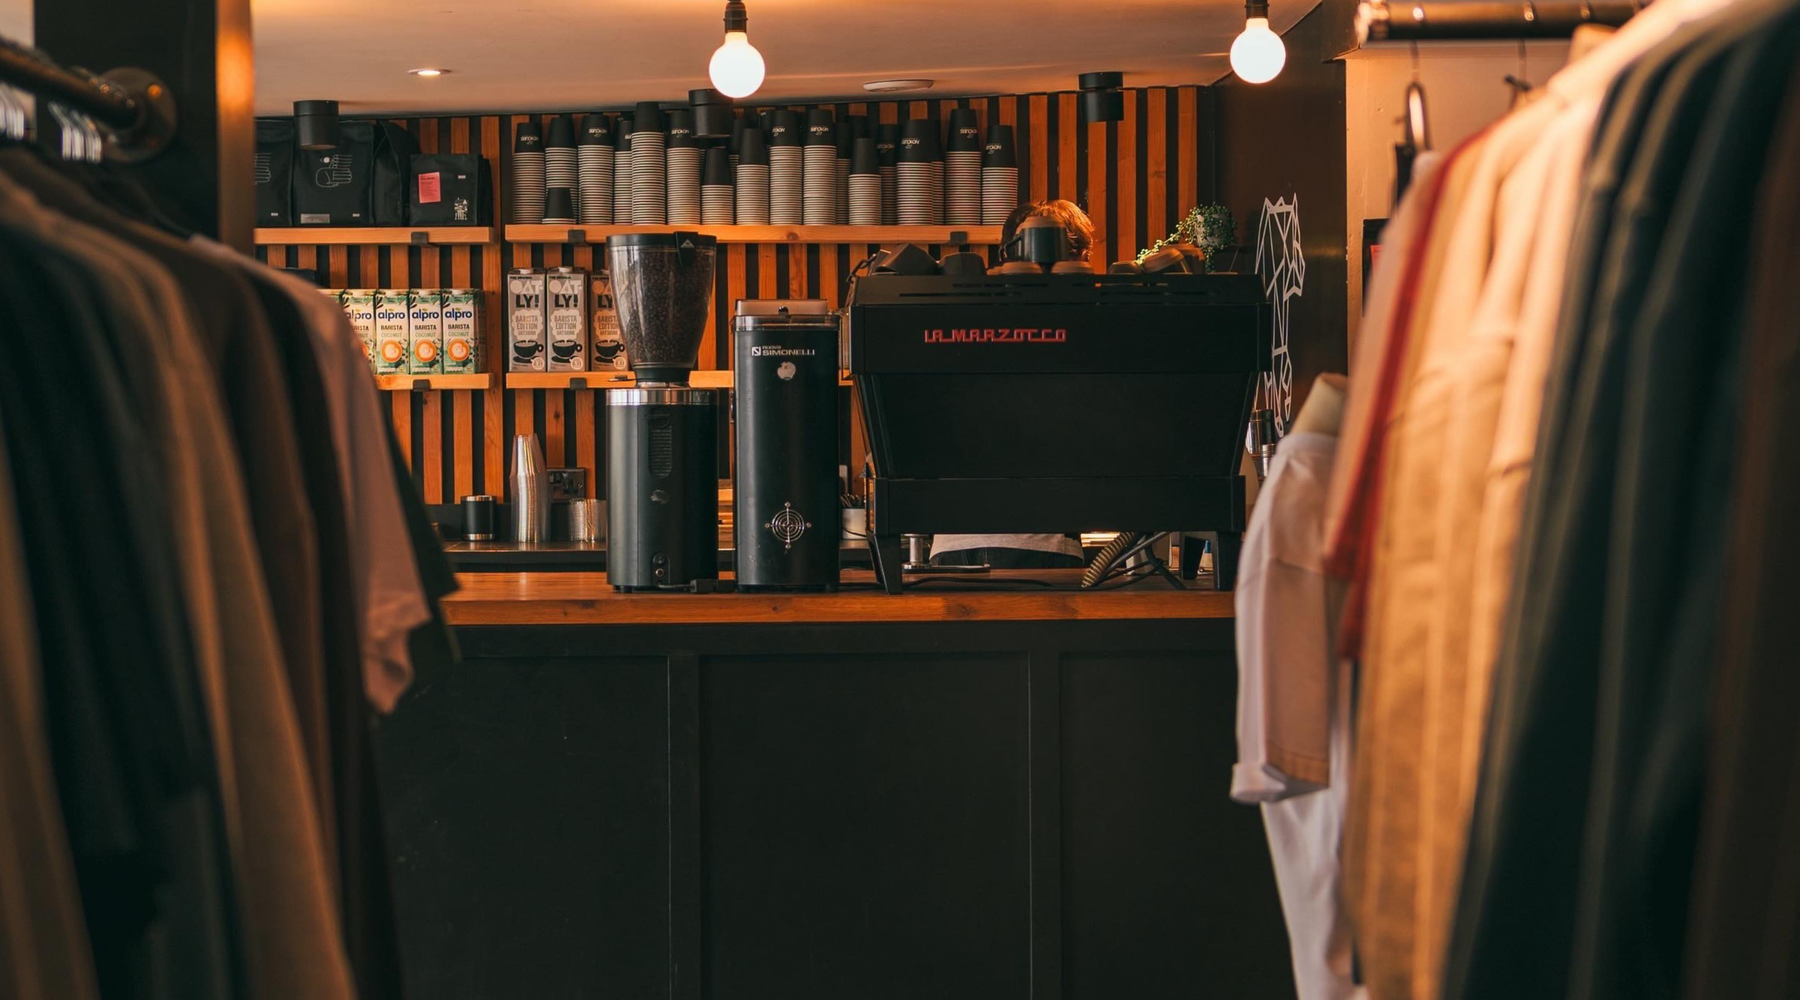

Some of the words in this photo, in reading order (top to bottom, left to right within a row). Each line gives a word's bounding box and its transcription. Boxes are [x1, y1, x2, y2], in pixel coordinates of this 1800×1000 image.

[516, 294, 539, 308] LY!
[555, 294, 578, 308] LY!
[597, 294, 613, 308] LY
[378, 309, 405, 321] alpro
[412, 308, 439, 321] alpro
[445, 308, 472, 321] alpro
[925, 329, 943, 342] LA
[952, 328, 1066, 342] MARZOCCO
